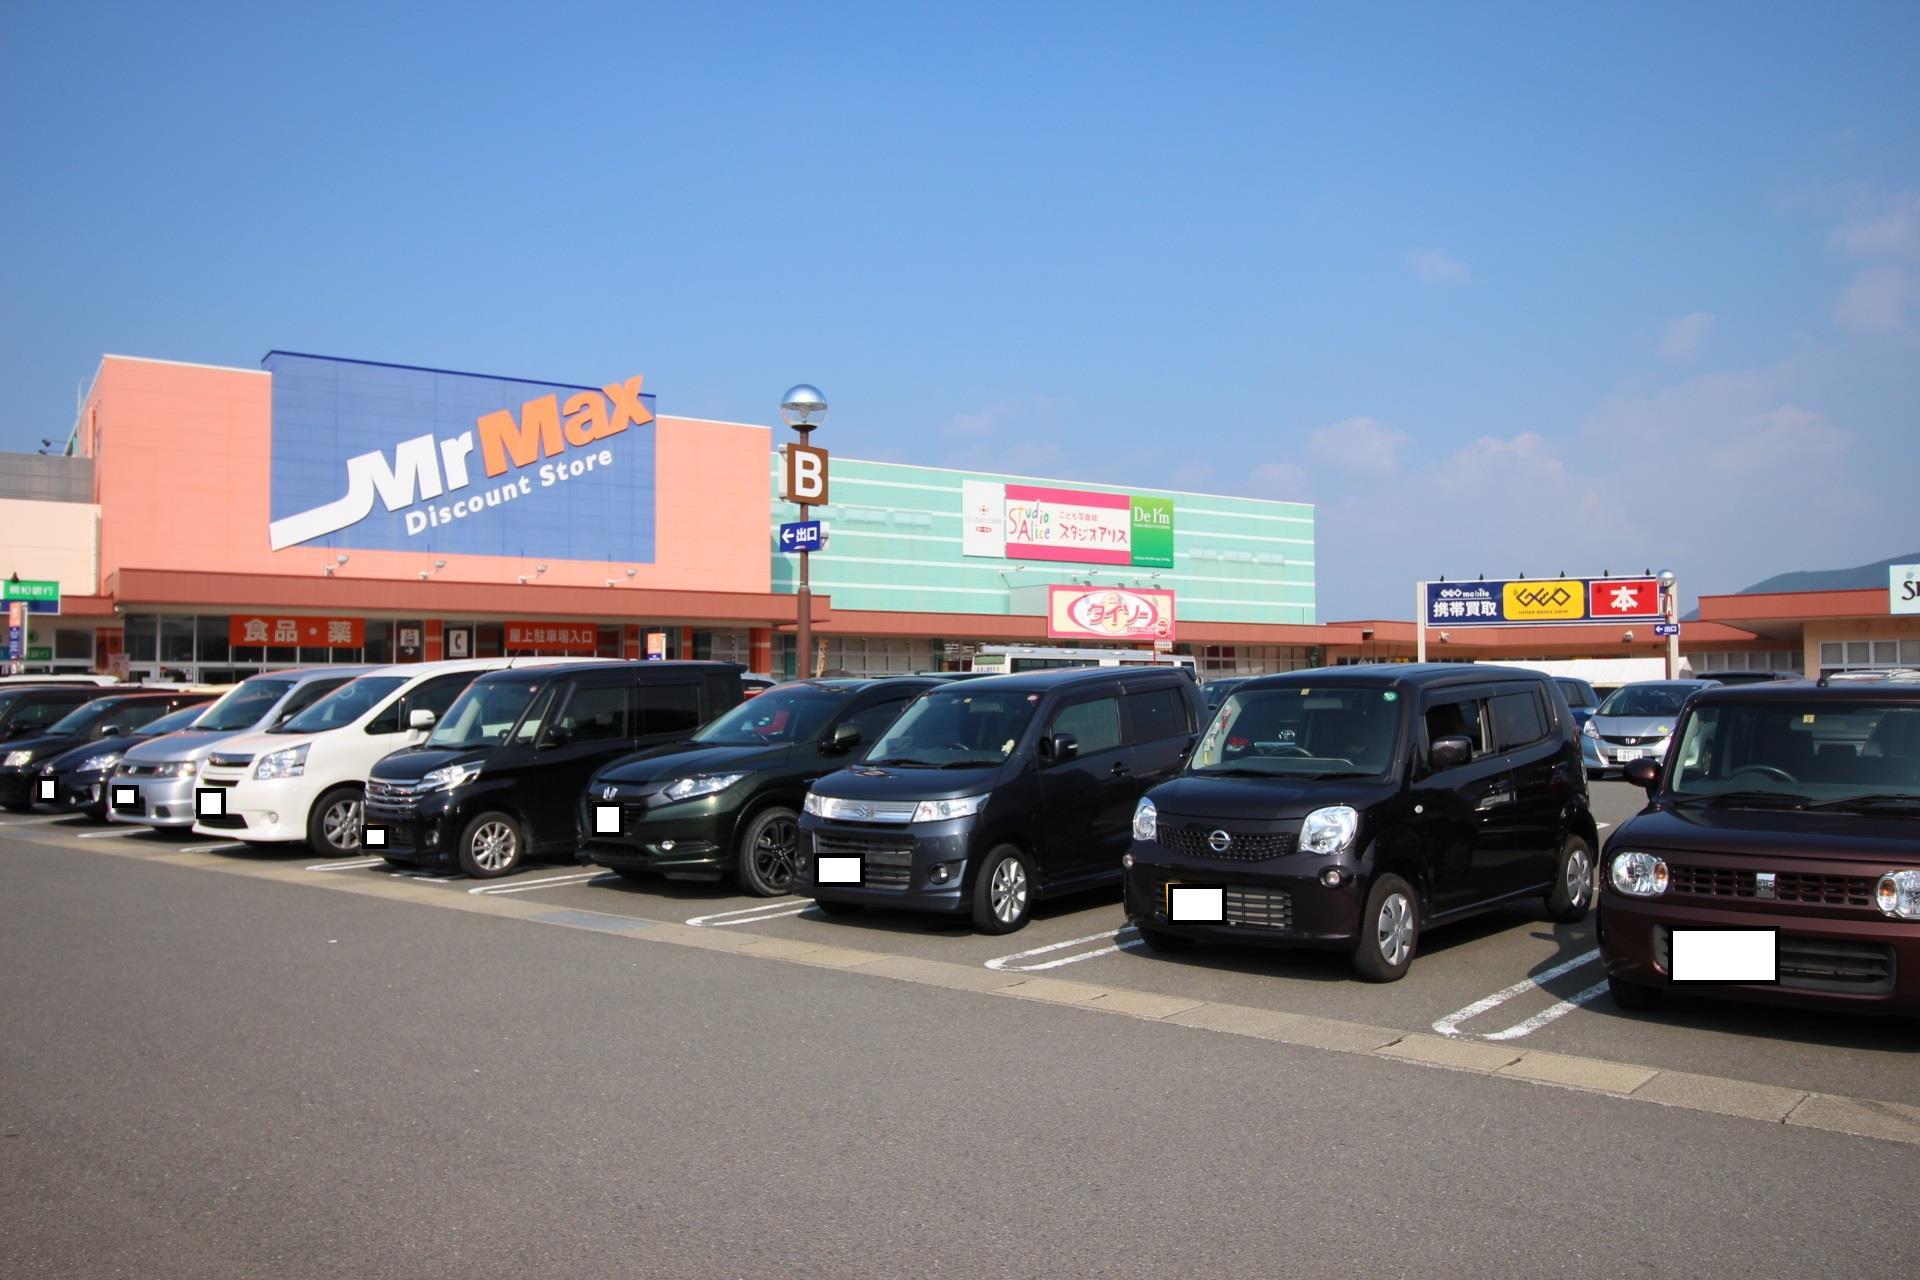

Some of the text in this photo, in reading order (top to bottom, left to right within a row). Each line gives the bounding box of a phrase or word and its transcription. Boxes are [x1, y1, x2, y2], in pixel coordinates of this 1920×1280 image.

[794, 450, 823, 498] B
[405, 449, 613, 536] Discount Store
[1008, 501, 1050, 534] Studio
[796, 527, 818, 542] 出口
[1016, 520, 1050, 542] Alice
[1059, 523, 1128, 543] スタジオアリス
[1462, 588, 1490, 598] mobile
[1516, 587, 1571, 607] GEO
[1610, 585, 1639, 612] 本
[1433, 600, 1497, 618] 携帯買取
